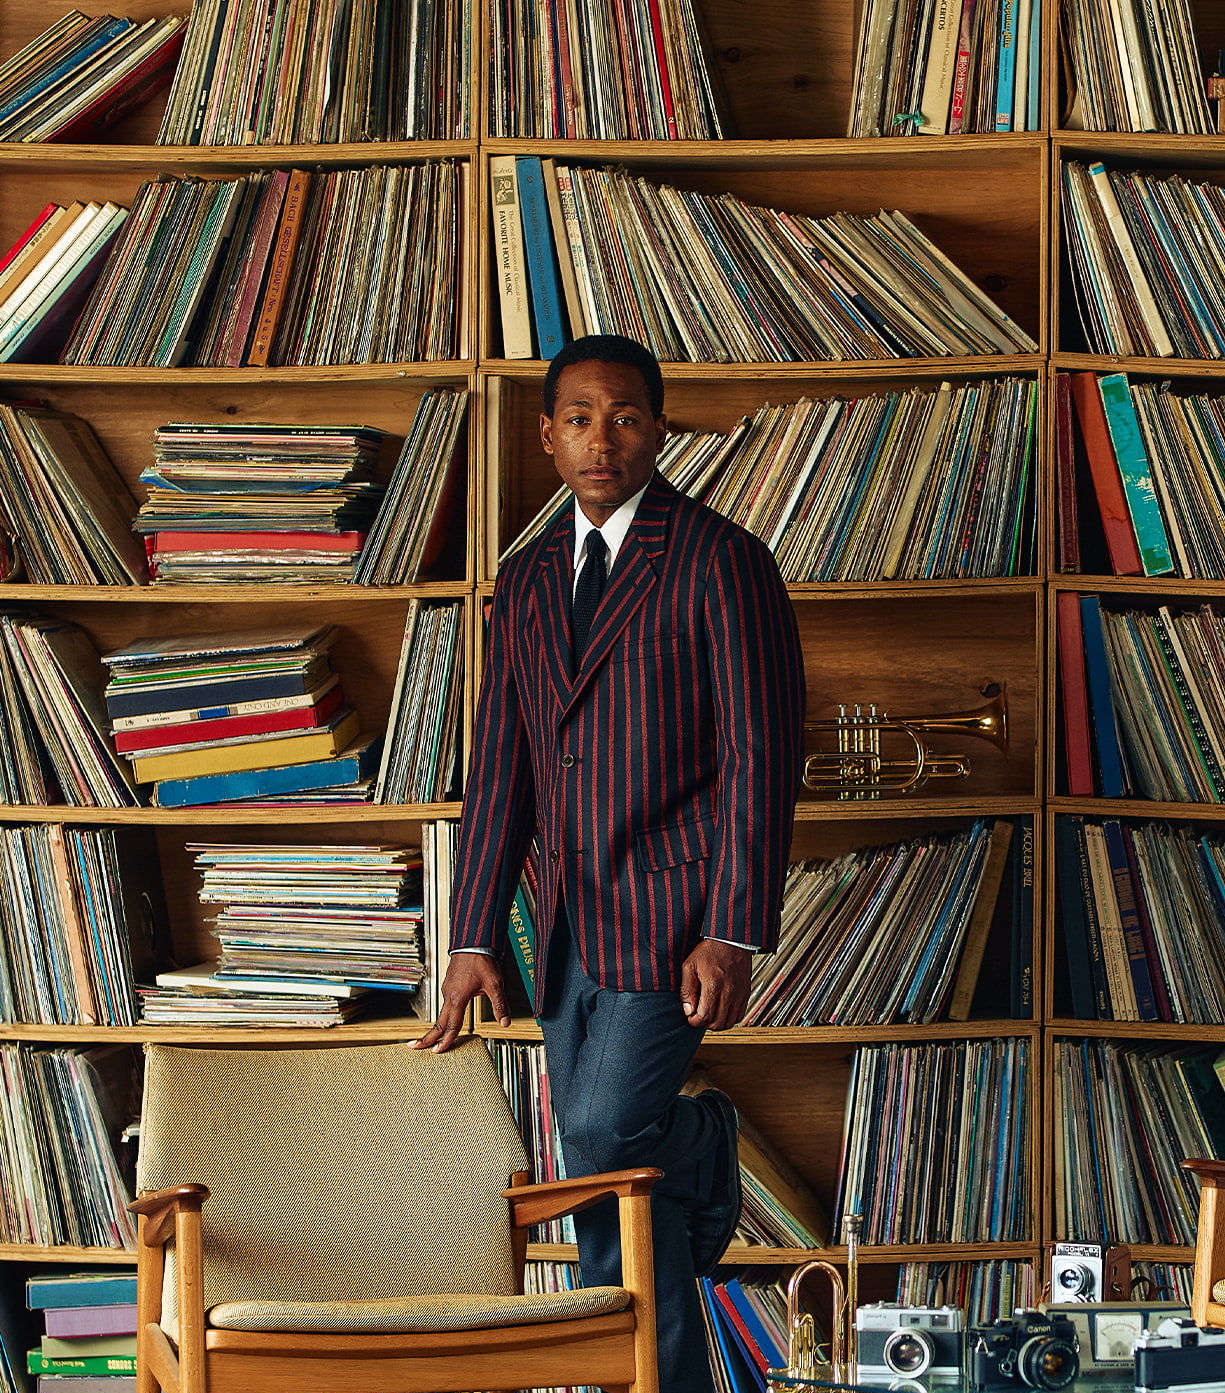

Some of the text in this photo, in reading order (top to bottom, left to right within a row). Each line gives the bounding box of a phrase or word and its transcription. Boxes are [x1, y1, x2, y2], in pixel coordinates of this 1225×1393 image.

[287, 195, 298, 223] BACH
[498, 210, 513, 296] FAVORITE HOME MUSIC
[511, 237, 519, 265] Collection
[513, 273, 521, 296] Classical
[242, 698, 299, 711] ONE AND ONLY
[1022, 826, 1033, 887] JACQUES BREL
[517, 935, 535, 965] PLUS
[1098, 990, 1106, 1010] PHILIPS
[1027, 1325, 1051, 1334] Canon
[107, 1360, 132, 1369] SOUNDS
